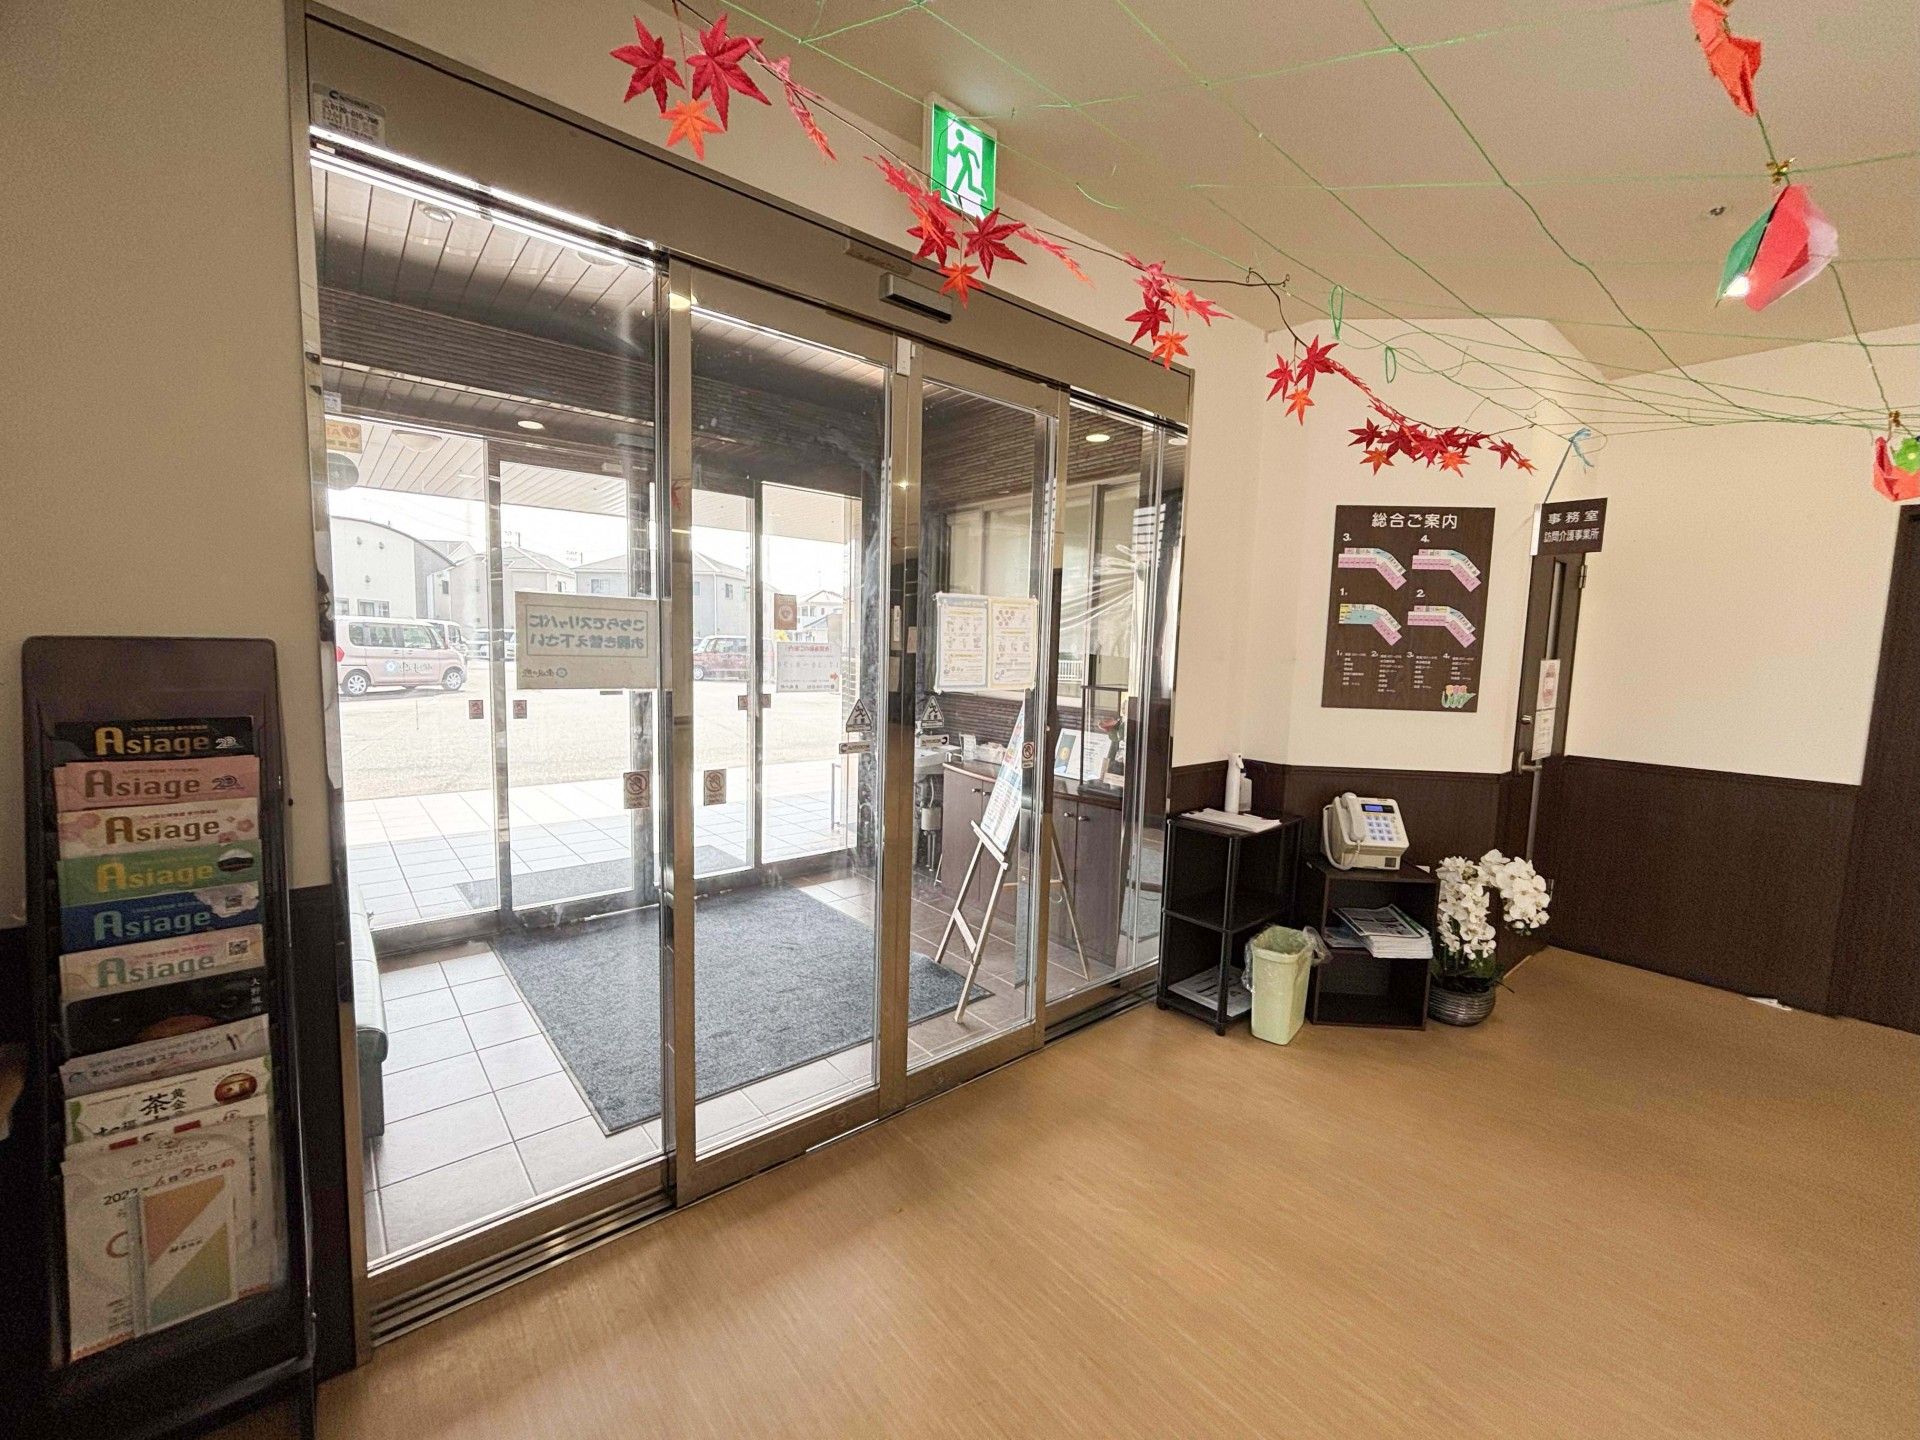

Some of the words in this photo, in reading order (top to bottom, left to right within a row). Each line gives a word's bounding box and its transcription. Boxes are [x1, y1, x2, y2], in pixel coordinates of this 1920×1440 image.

[1371, 512, 1458, 530] 総合ご案内
[1547, 510, 1599, 524] 事務室
[1543, 528, 1600, 543] 訪問介護事業所
[95, 726, 209, 756] Asiage
[84, 768, 201, 799] Asiage
[105, 815, 220, 845] Asiage
[95, 862, 215, 893] Asiage
[93, 909, 212, 941] Asiage
[97, 953, 215, 988] Asiage
